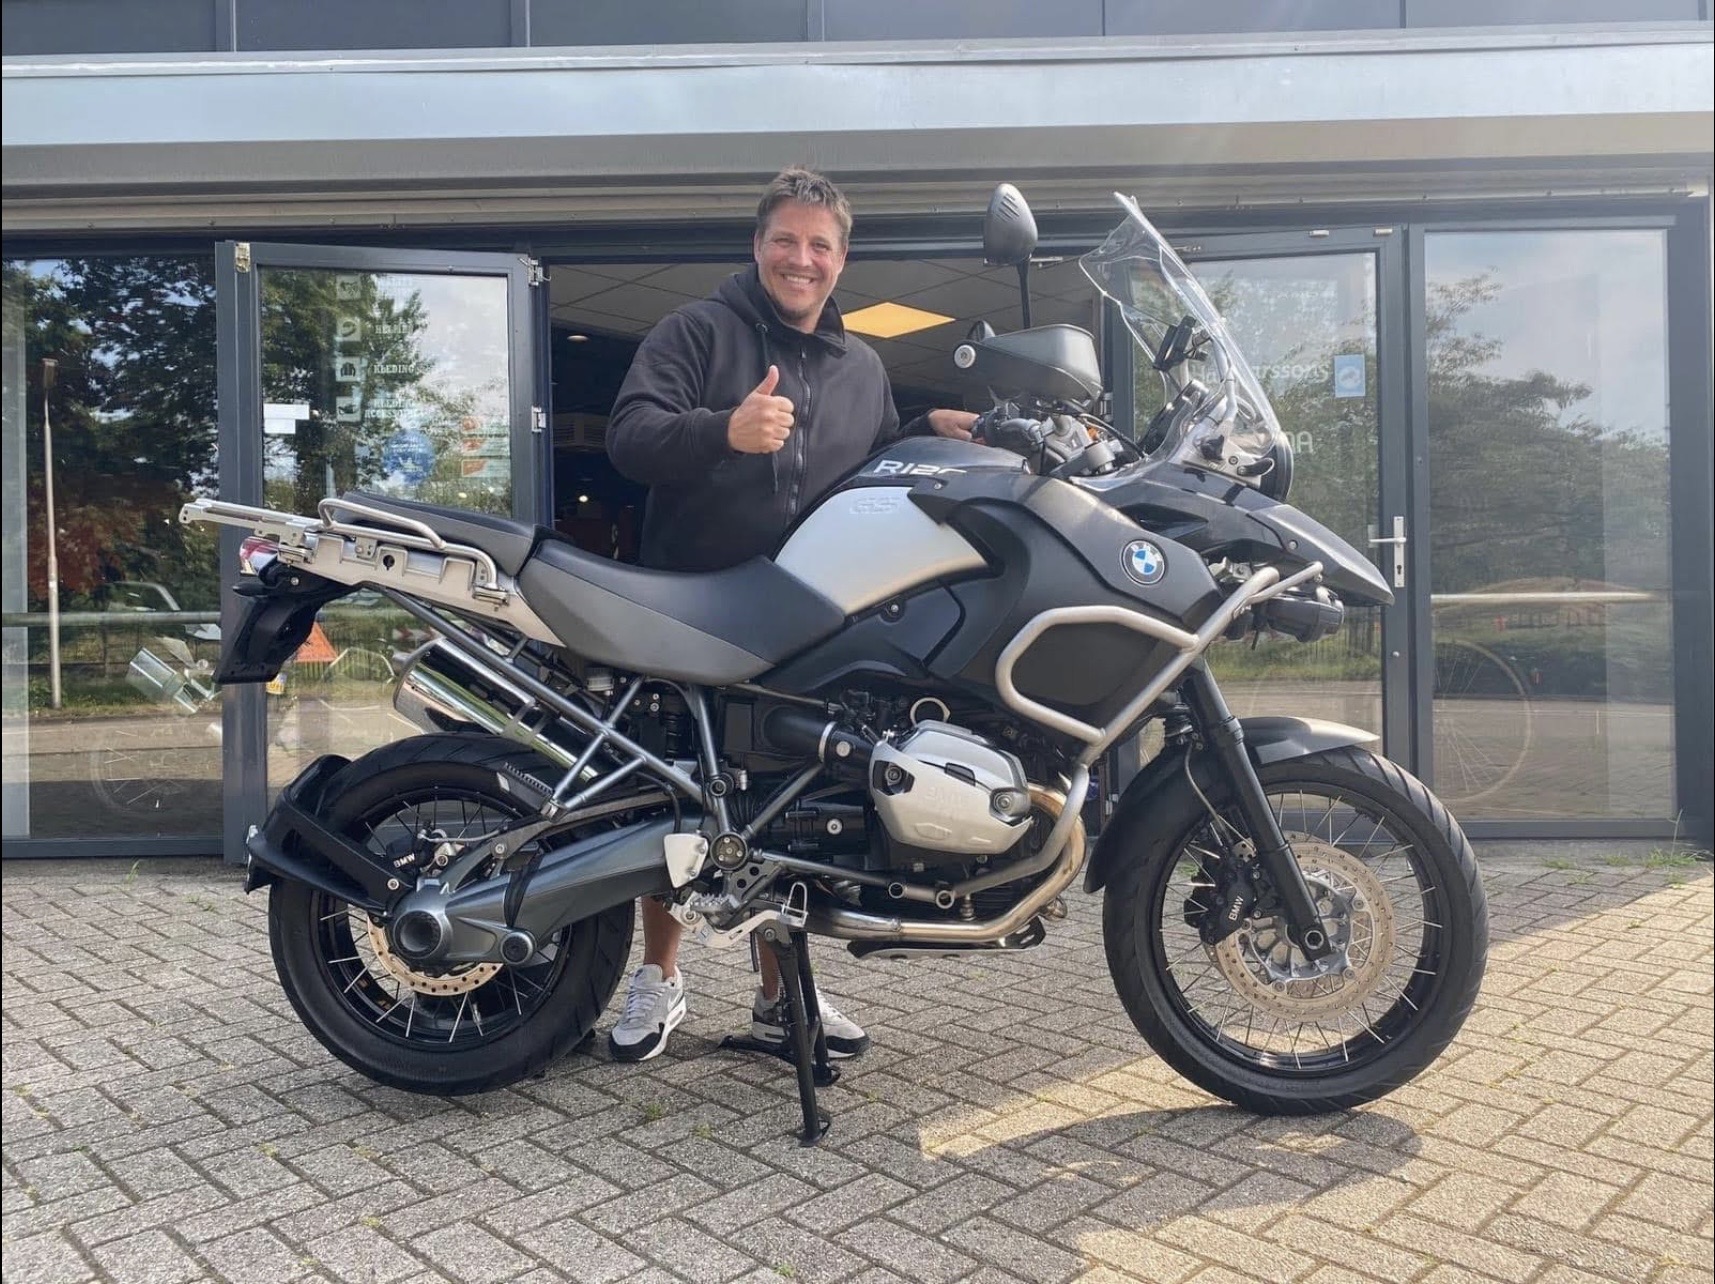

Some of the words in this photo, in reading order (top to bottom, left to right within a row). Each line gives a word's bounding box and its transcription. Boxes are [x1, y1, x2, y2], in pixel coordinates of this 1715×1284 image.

[373, 364, 415, 374] KLEDING
[393, 852, 415, 868] BMW
[1228, 895, 1244, 921] BMW
